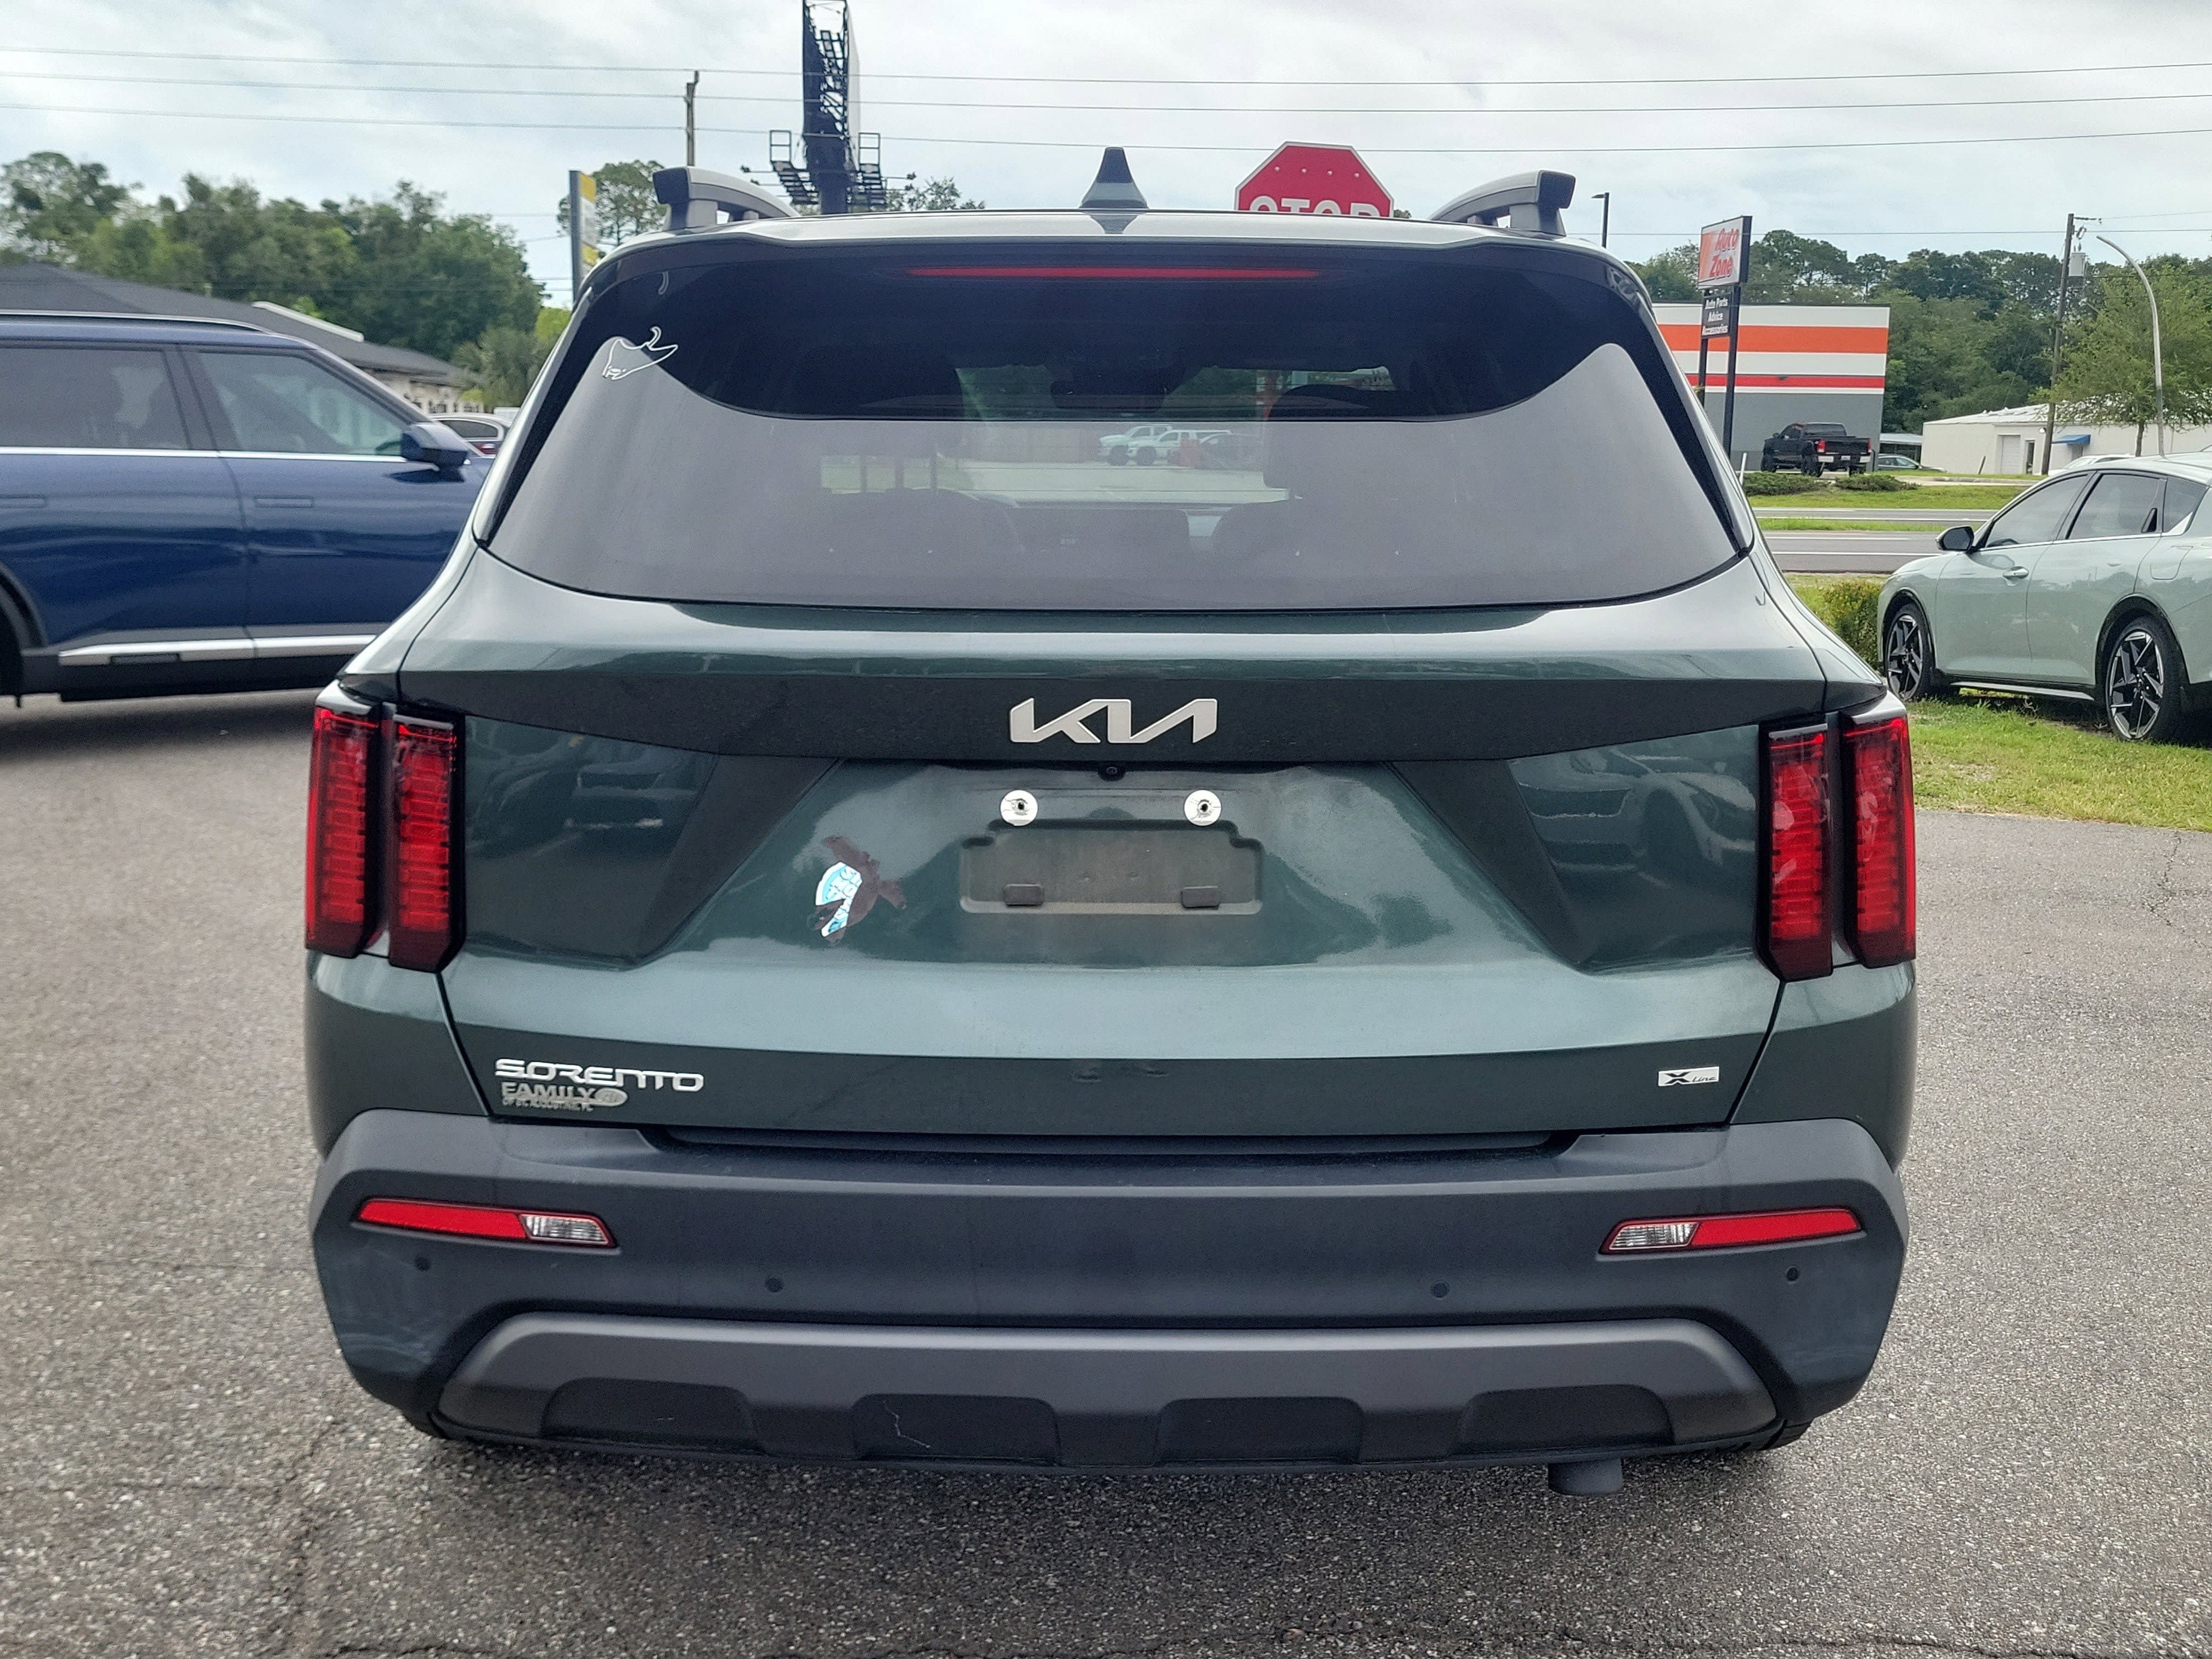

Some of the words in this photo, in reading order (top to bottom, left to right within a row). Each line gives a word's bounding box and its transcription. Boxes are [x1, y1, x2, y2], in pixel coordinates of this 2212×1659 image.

[1715, 228, 1740, 251] Auto
[1709, 256, 1734, 277] Zone
[1010, 698, 1218, 743] KIA
[495, 1058, 704, 1092] SORENTO
[501, 1081, 596, 1099] FAMILY
